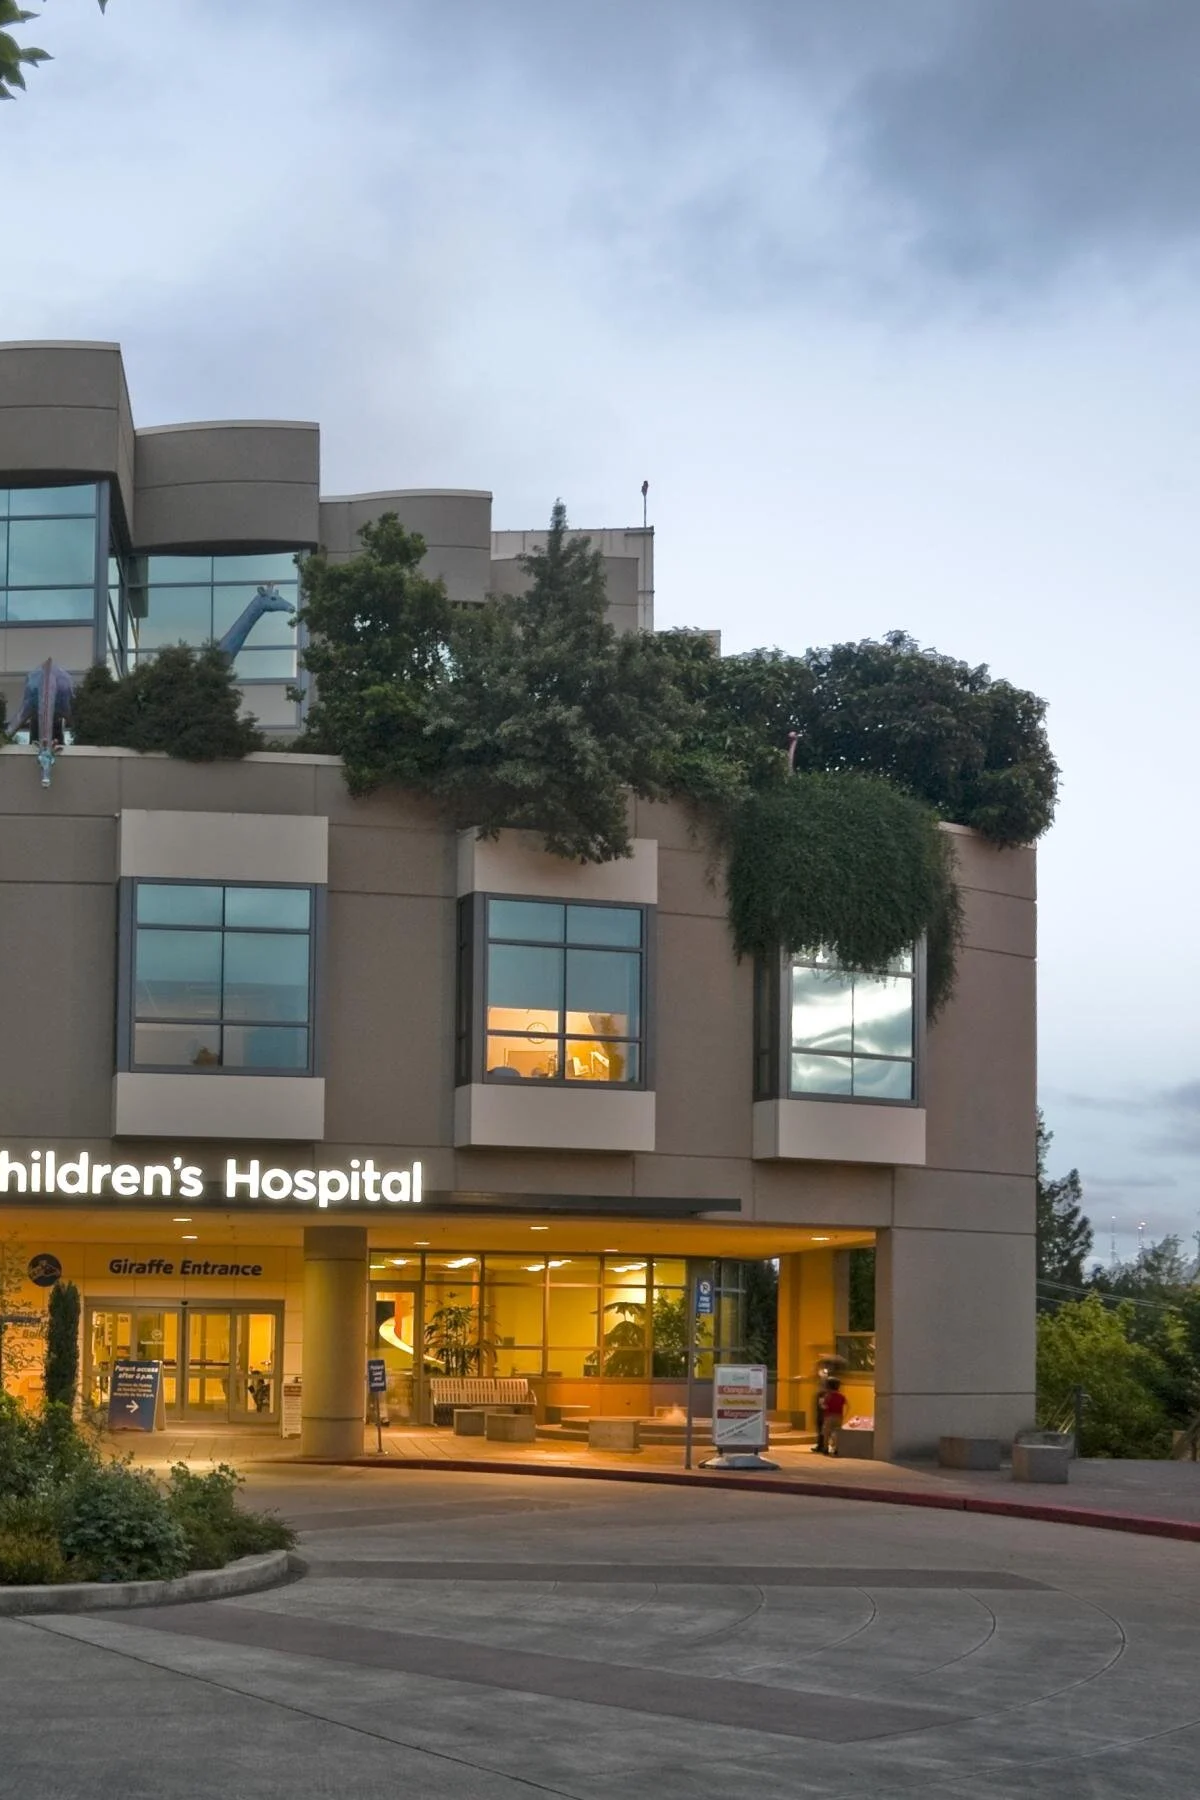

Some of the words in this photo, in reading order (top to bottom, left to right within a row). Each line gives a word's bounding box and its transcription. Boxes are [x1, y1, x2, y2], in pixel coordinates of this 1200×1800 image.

[226, 1158, 423, 1208] Hospital
[108, 1259, 174, 1275] Giraffe
[180, 1260, 263, 1276] Entrance
